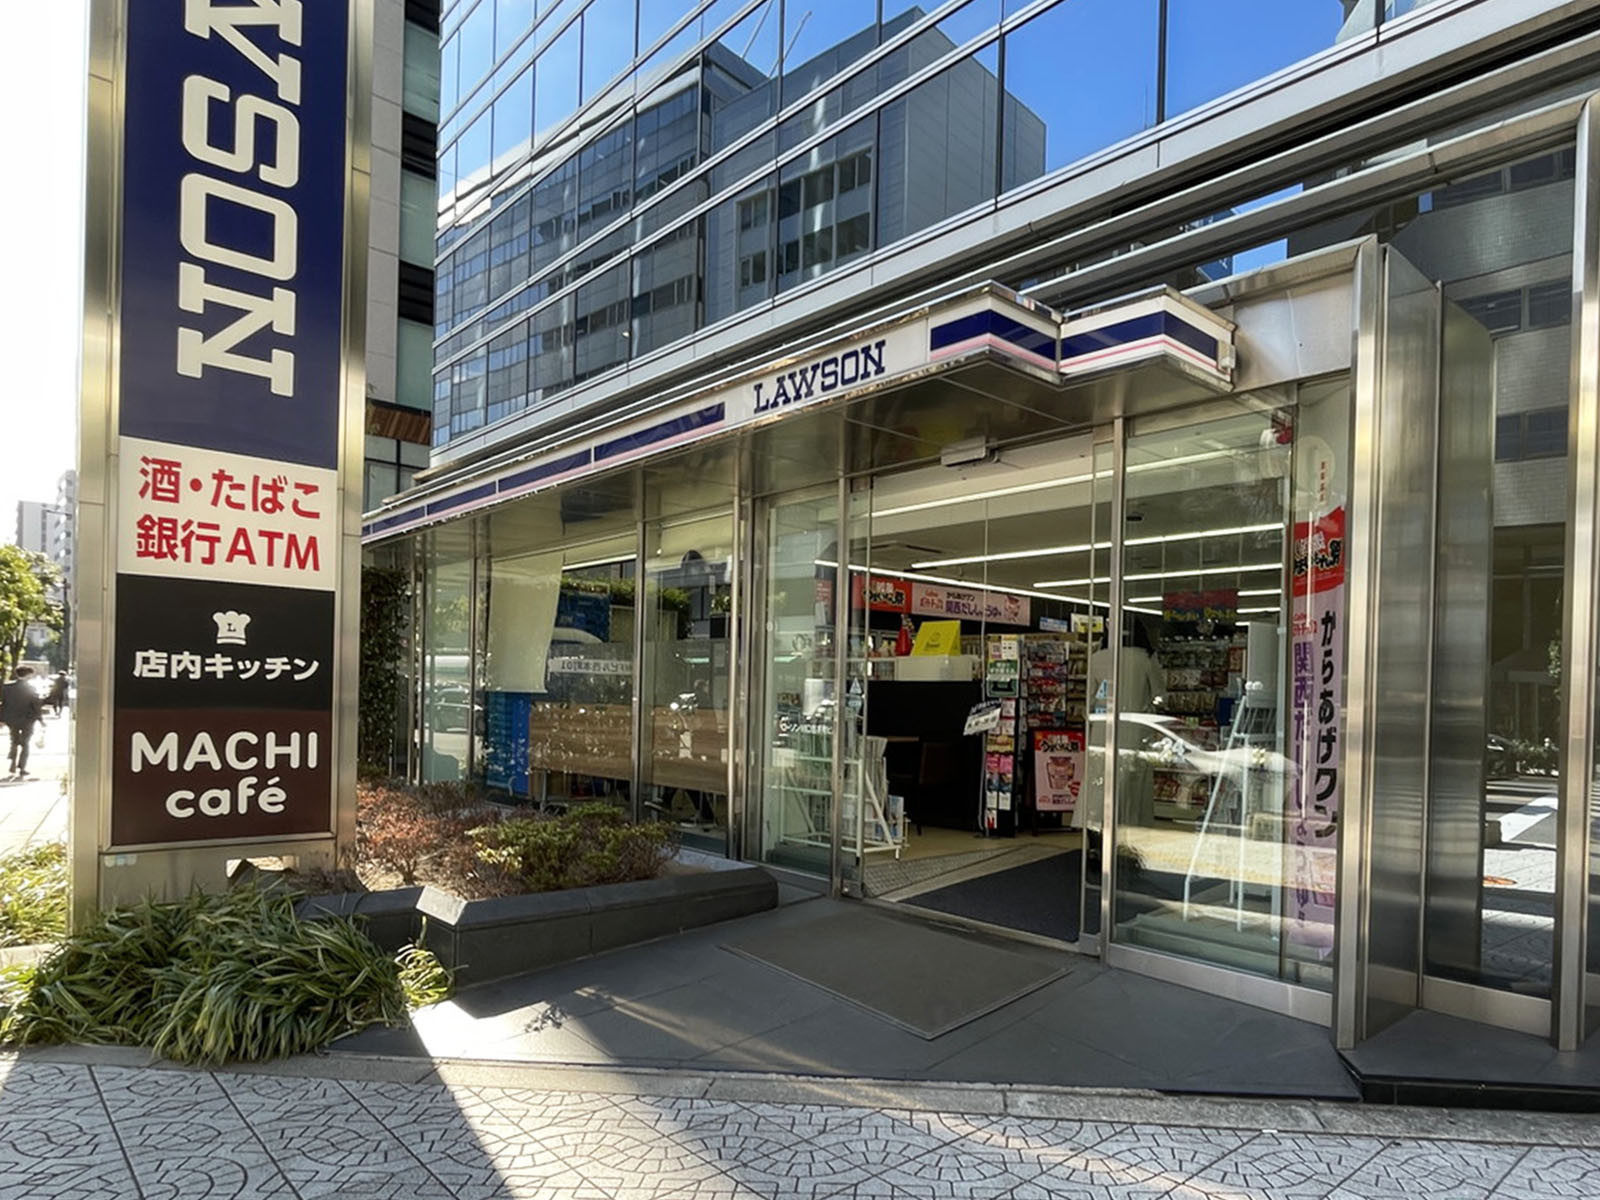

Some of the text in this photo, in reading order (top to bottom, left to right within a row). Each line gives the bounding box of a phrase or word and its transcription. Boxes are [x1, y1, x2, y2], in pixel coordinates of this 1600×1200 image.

[753, 339, 886, 414] LAWSON
[138, 455, 321, 519] 酒・たばこ
[136, 514, 320, 572] 銀行ATM
[132, 649, 320, 681] 店内キッチン
[130, 730, 318, 773] MACHI
[1314, 609, 1337, 838] からあげクン
[165, 775, 287, 819] café
